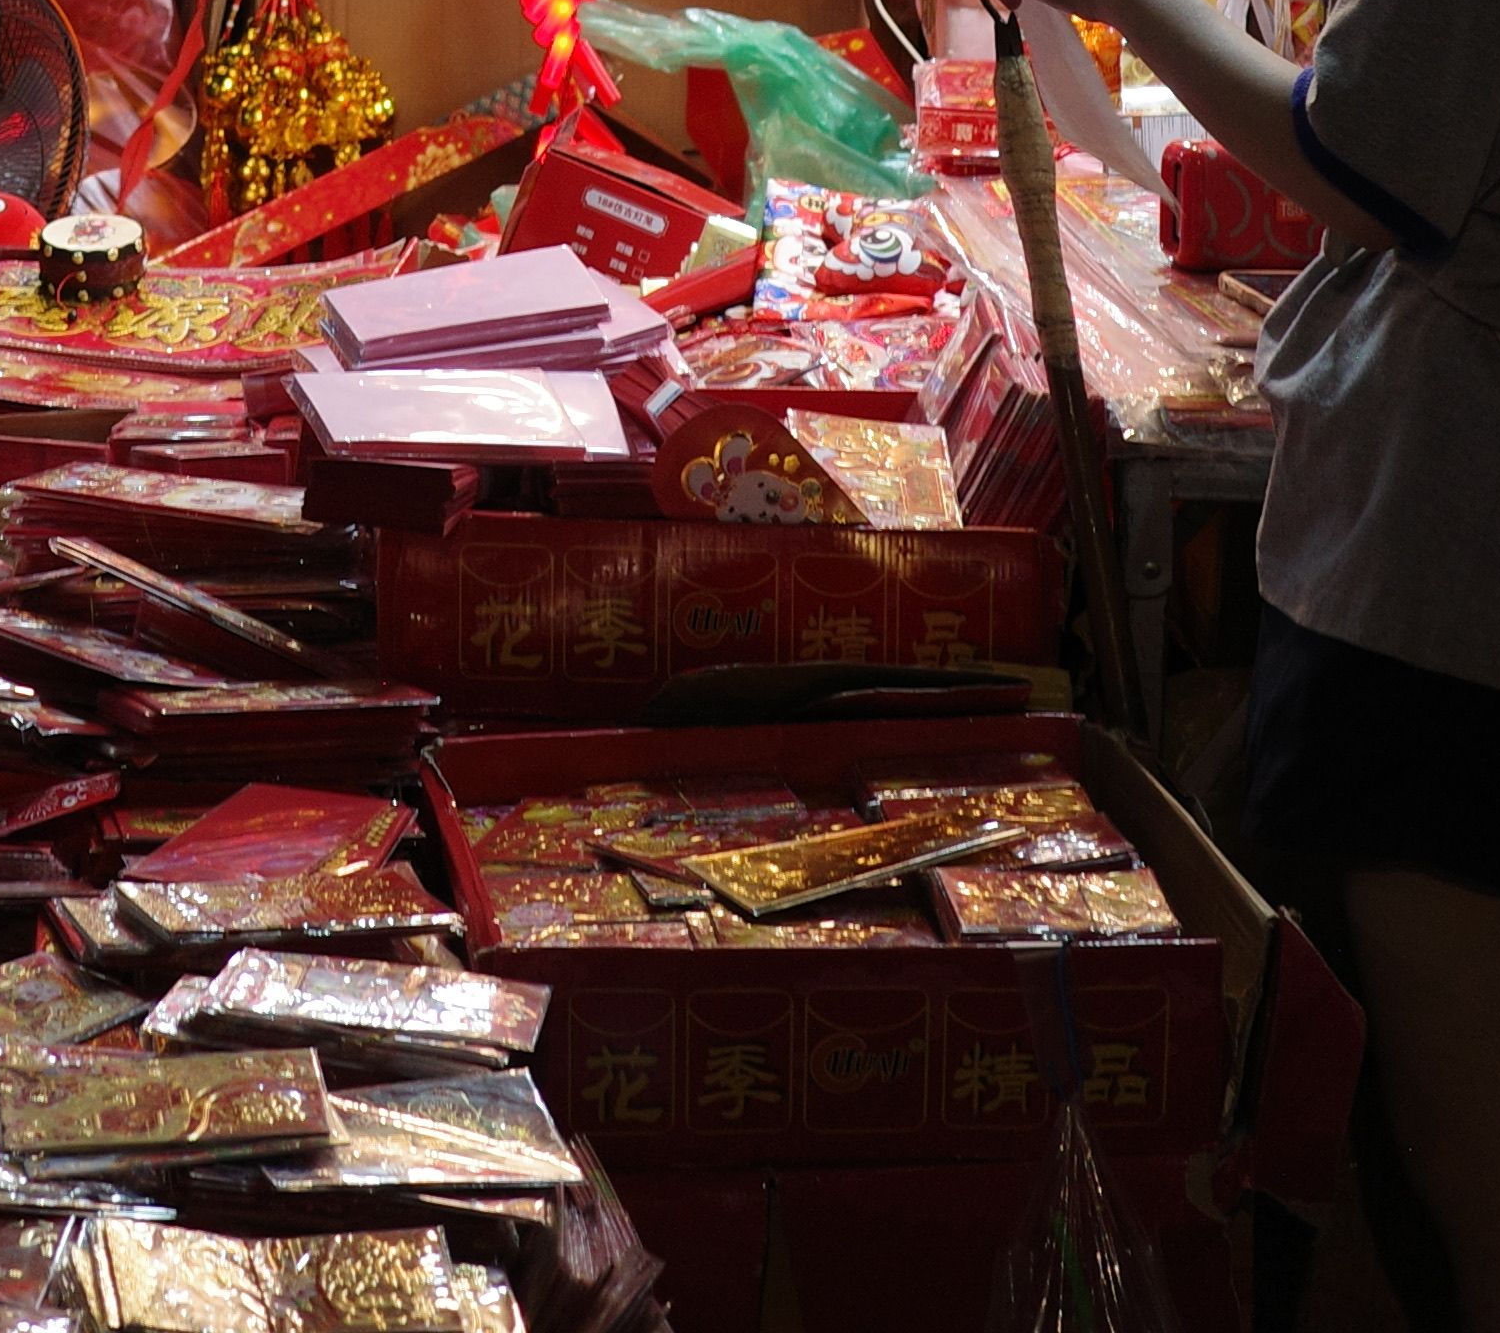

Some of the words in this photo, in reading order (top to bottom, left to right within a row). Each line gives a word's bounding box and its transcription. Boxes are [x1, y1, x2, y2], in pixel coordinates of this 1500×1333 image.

[471, 594, 649, 668] 花季
[801, 604, 977, 665] 精品
[582, 1041, 782, 1125] 花季
[954, 1041, 1149, 1113] 精品
